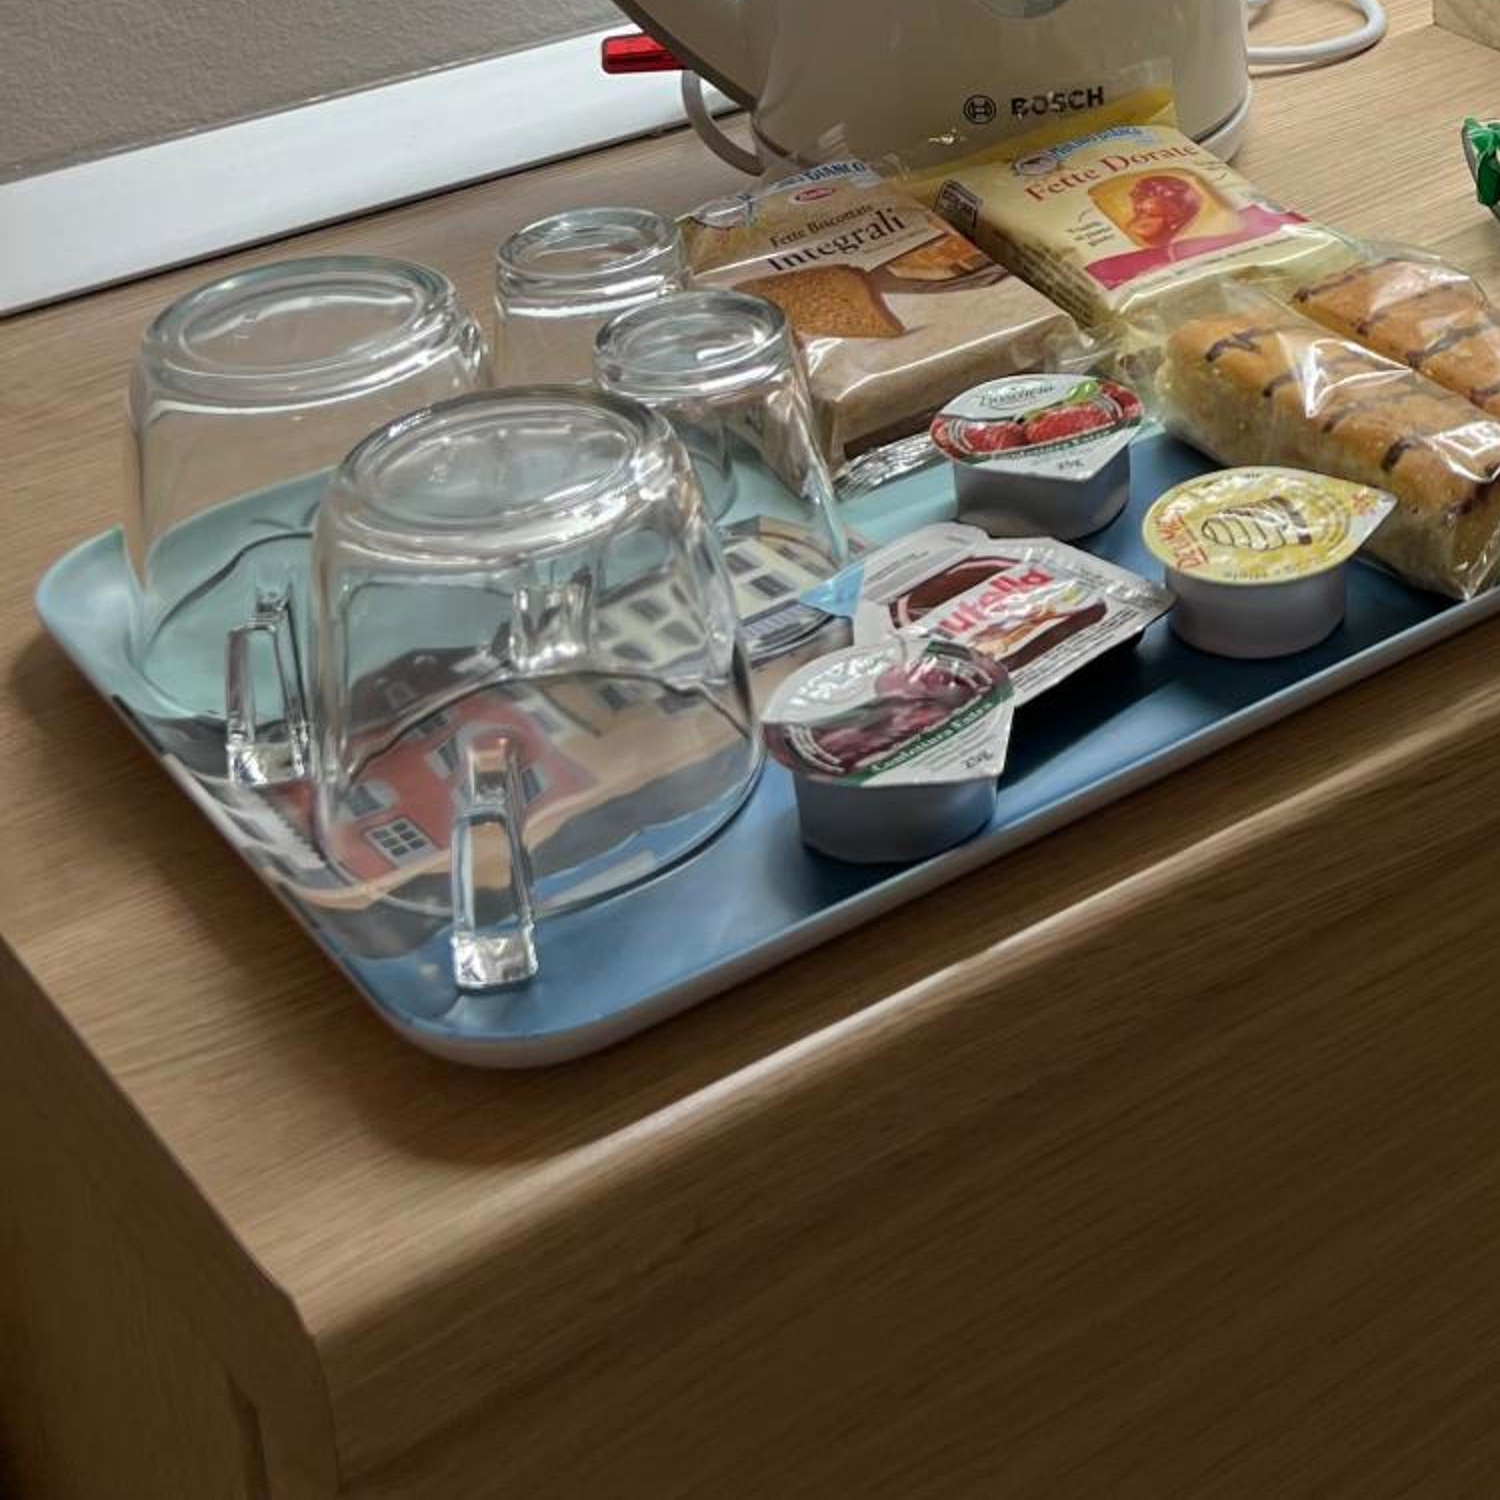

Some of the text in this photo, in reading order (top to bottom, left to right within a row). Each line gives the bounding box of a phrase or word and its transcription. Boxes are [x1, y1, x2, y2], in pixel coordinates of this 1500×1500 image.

[1010, 85, 1105, 119] BOSCH
[1024, 143, 1200, 201] Fette Dorate
[766, 206, 907, 273] Integrali
[769, 226, 804, 249] Fette
